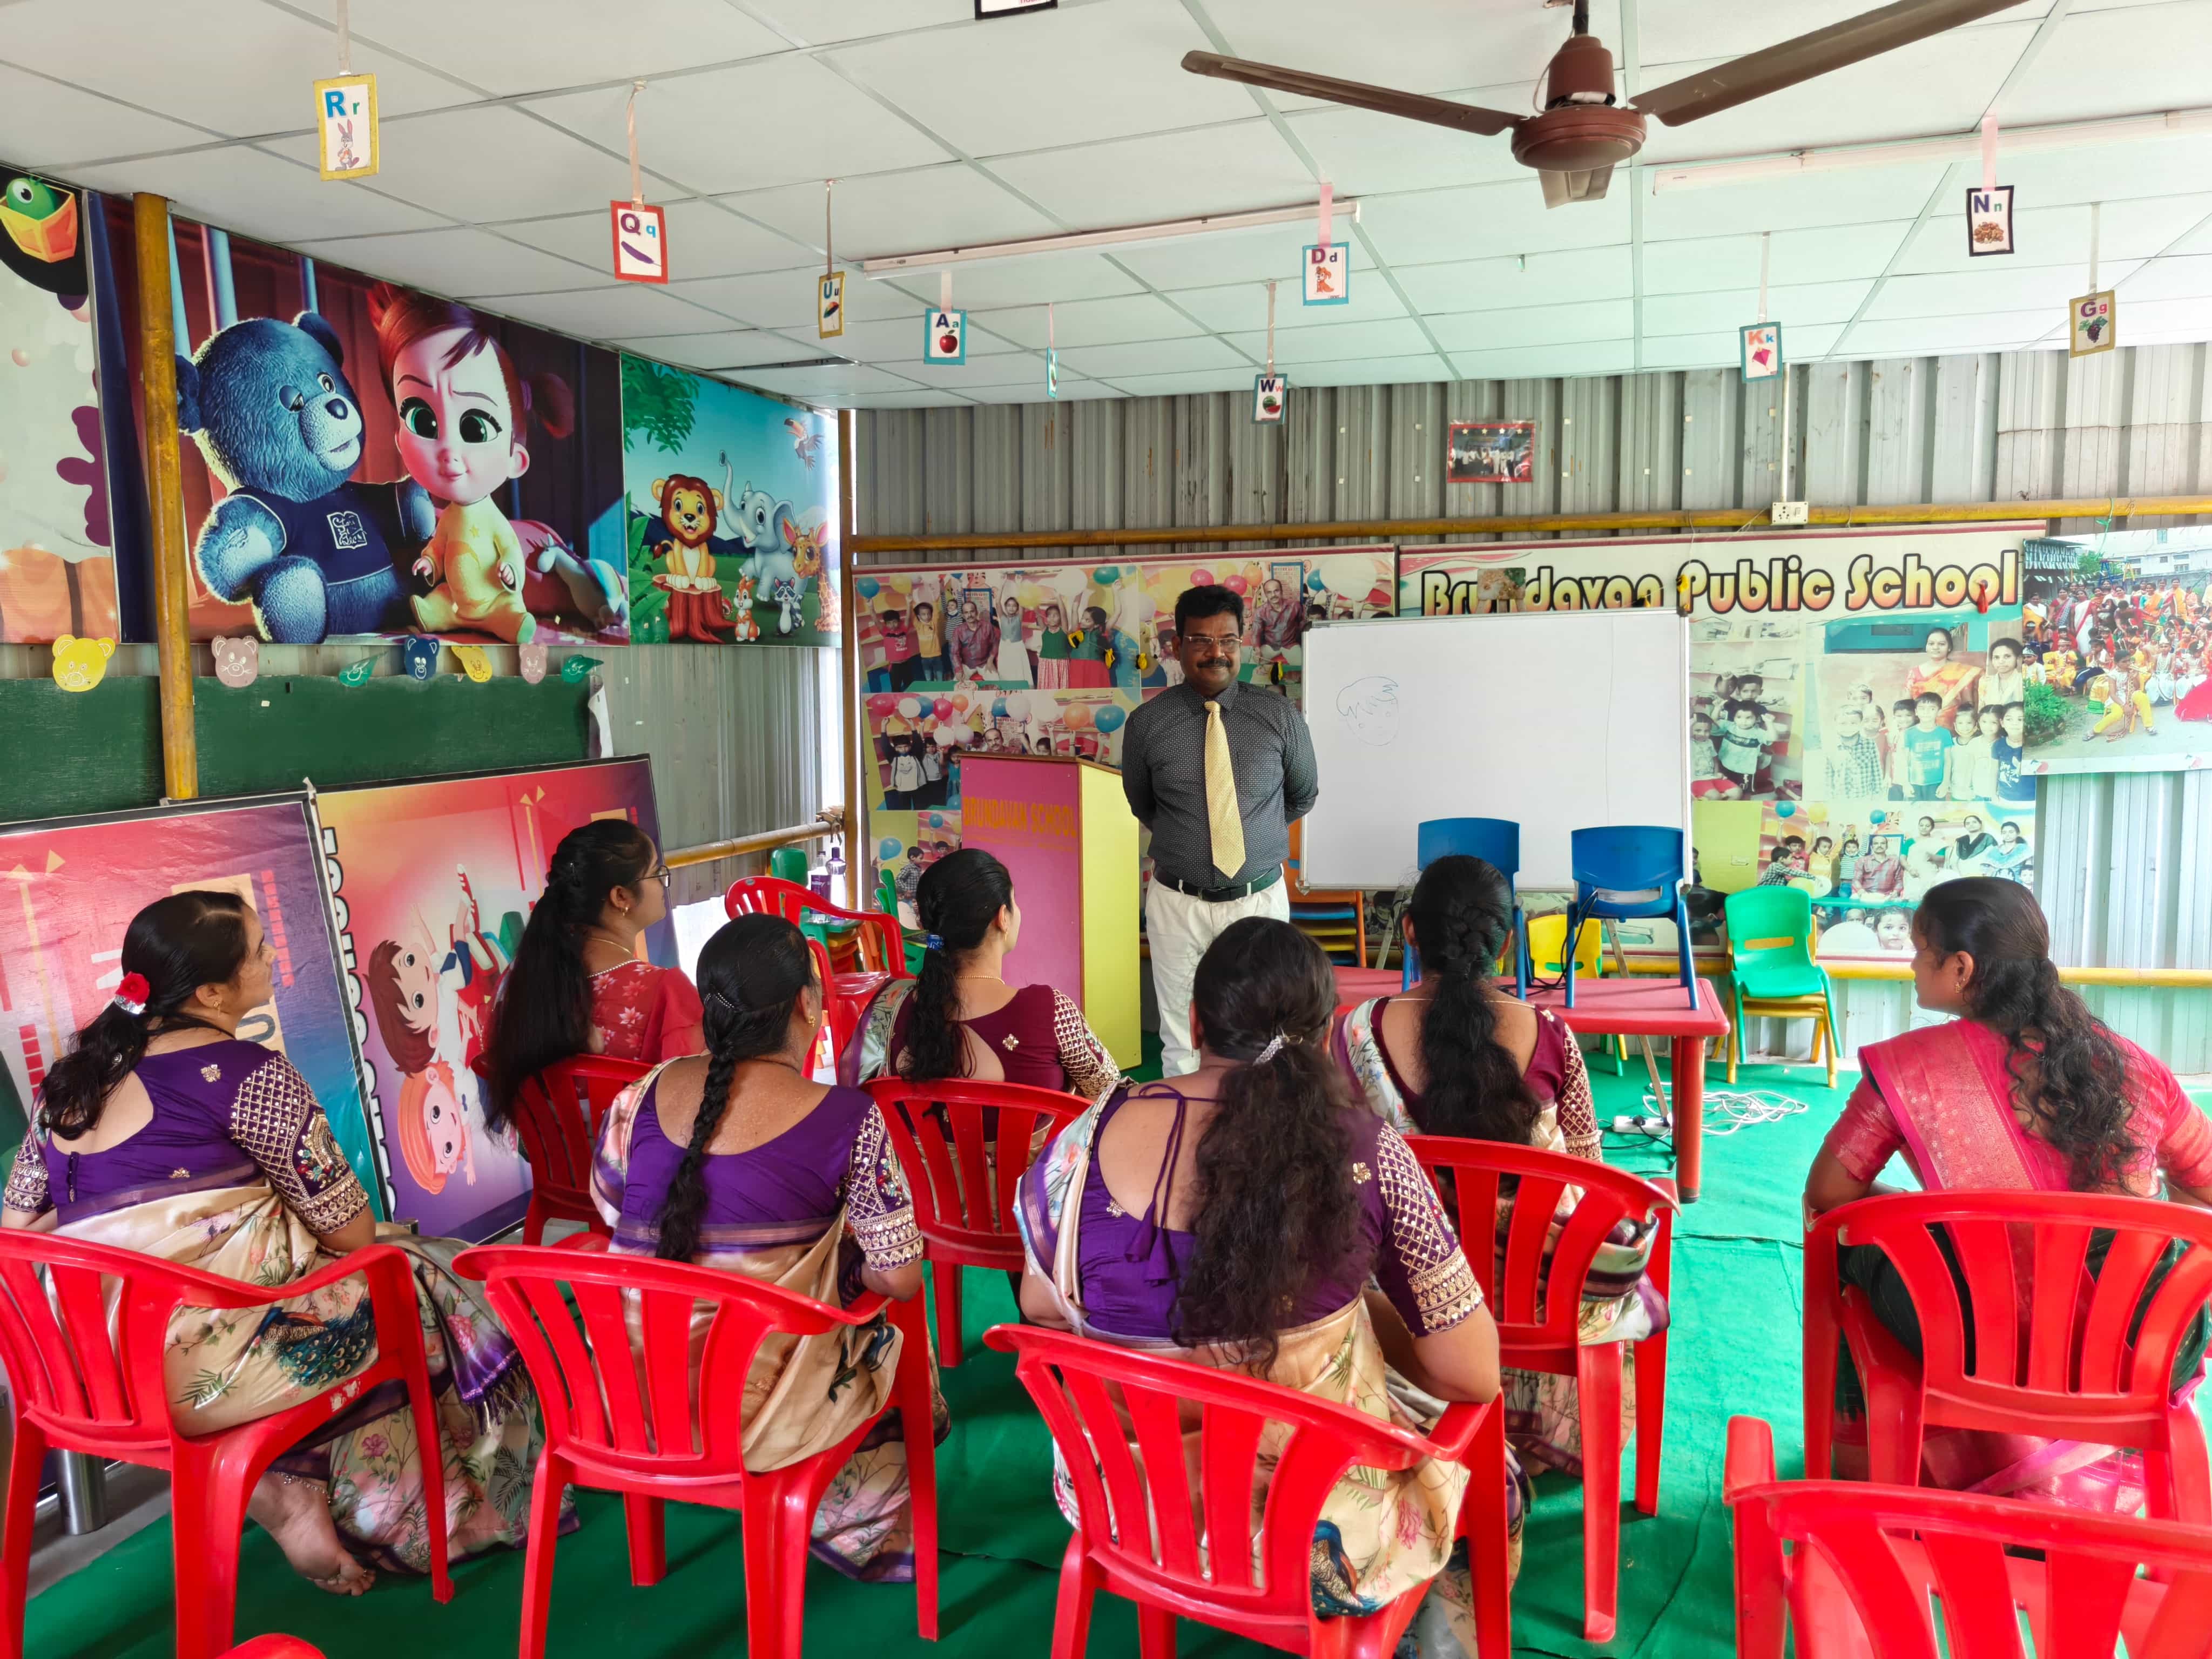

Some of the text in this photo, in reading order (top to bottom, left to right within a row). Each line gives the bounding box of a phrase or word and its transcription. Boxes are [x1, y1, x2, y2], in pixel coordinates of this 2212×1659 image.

[324, 90, 360, 118] R r
[1974, 194, 2002, 213] N n
[620, 213, 656, 238] Q q
[1311, 248, 1338, 264] D d
[824, 281, 840, 299] U u
[2080, 301, 2107, 318] G g
[935, 313, 959, 328] A a
[1748, 329, 1774, 346] K k
[1260, 379, 1276, 392] W
[1421, 549, 2019, 616] Brudavan Public School
[1031, 803, 1077, 838] SCHOOL
